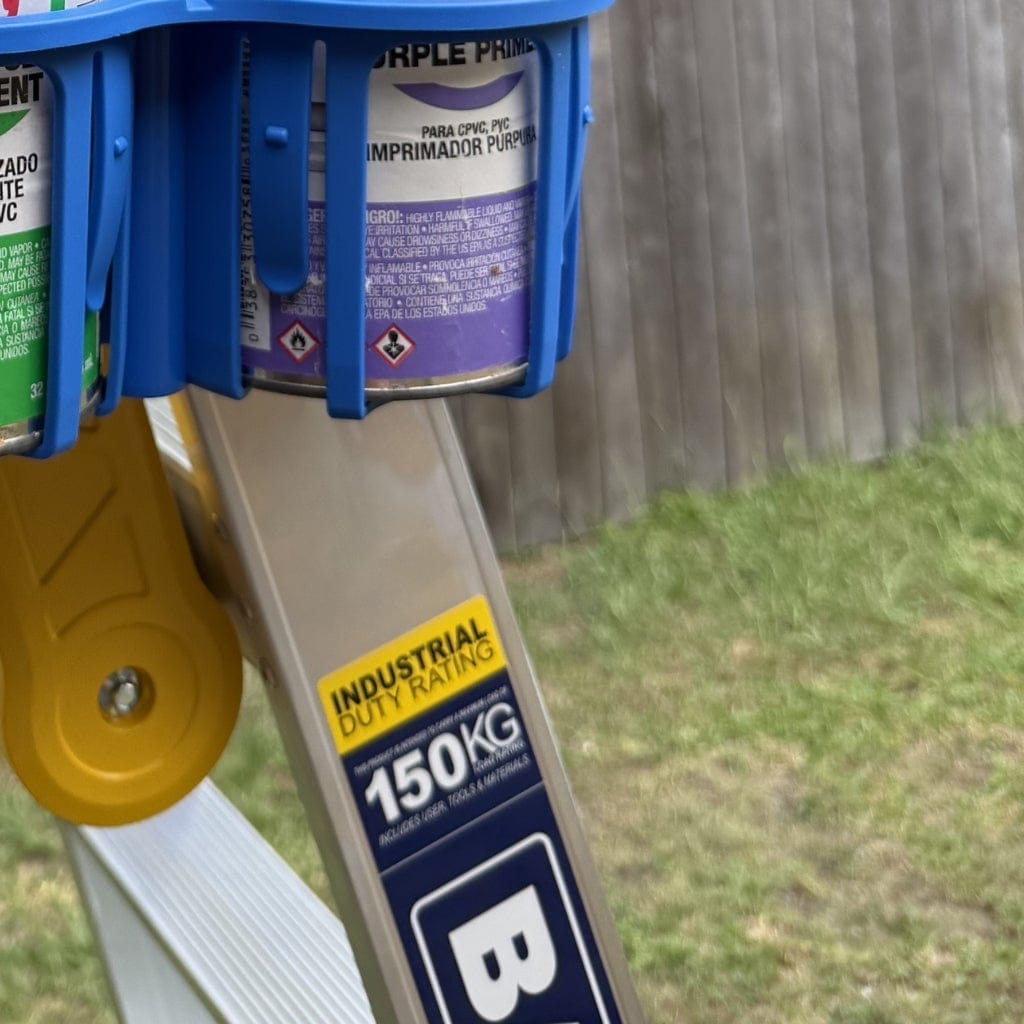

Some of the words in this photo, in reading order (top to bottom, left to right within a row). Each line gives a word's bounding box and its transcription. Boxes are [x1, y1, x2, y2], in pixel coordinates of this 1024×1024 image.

[421, 126, 455, 139] PARA
[458, 121, 488, 136] CPVC,
[491, 117, 510, 133] PVC
[366, 137, 483, 162] IMPRIMADOR
[406, 212, 433, 223] HIGHLY
[9, 242, 33, 257] VAPOR
[377, 236, 405, 247] CAUSE
[382, 246, 429, 258] CLASSIFIED
[430, 245, 440, 257] BY
[8, 256, 24, 271] MAY
[25, 252, 34, 265] BE
[0, 270, 16, 284] MAY
[17, 264, 40, 280] CAUSE
[4, 308, 25, 324] FATAL
[374, 308, 390, 319] EPA
[391, 308, 404, 319] DE
[405, 307, 421, 318] LOS
[11, 321, 18, 334] O
[30, 380, 45, 399] 32
[330, 617, 488, 714] INDUSTRIAL
[339, 686, 401, 738] DUTY
[408, 638, 495, 702] RATING
[364, 702, 521, 825] 150KG
